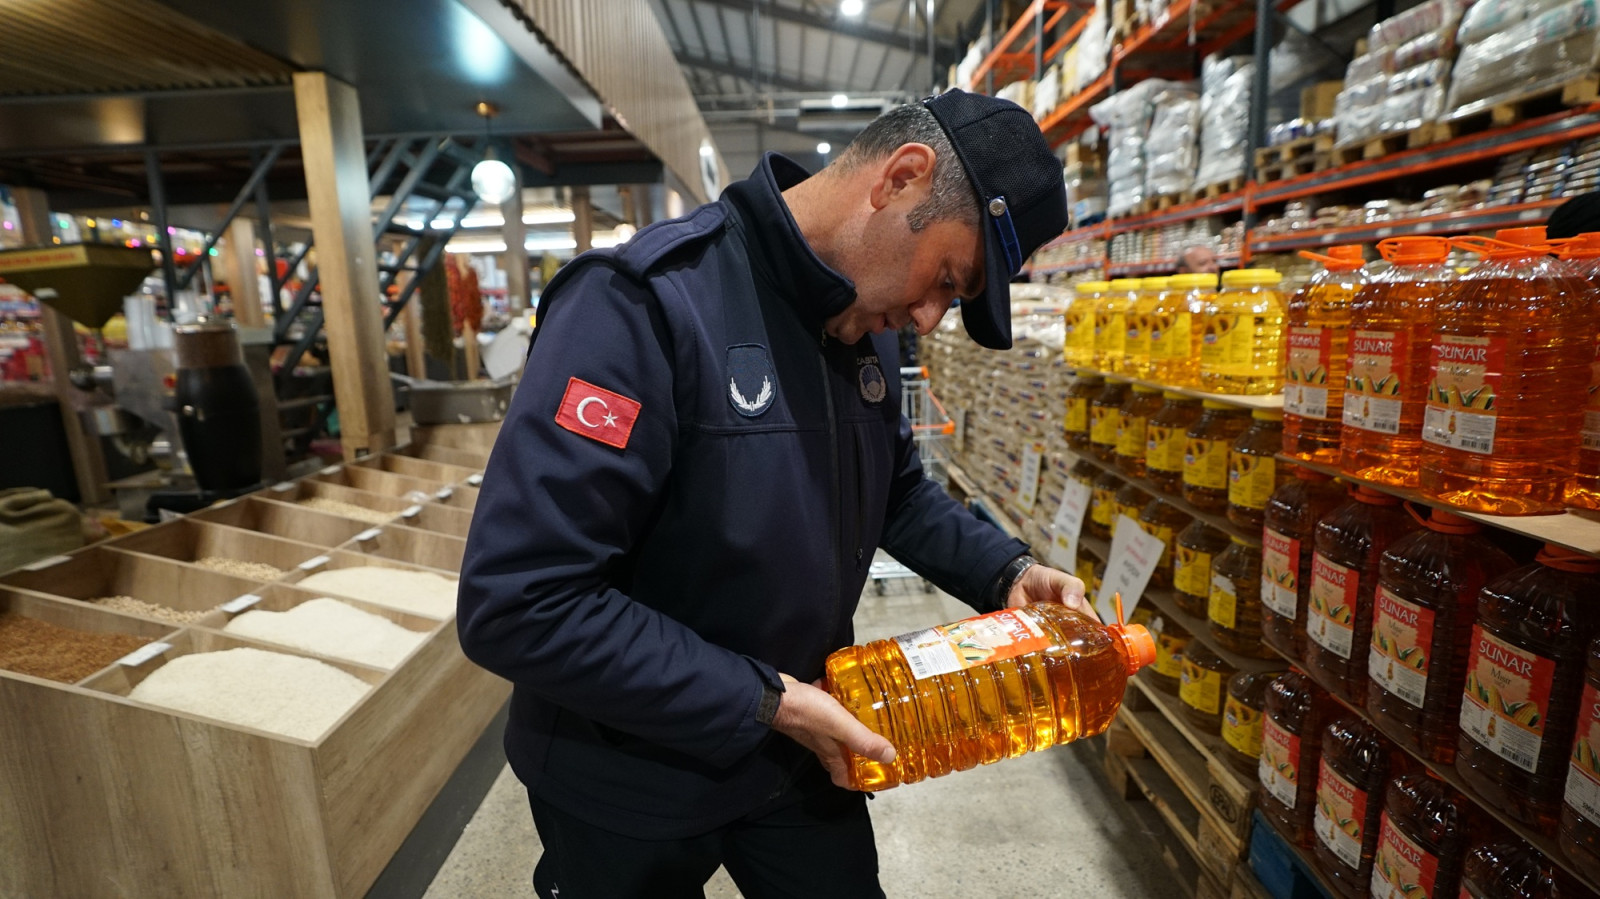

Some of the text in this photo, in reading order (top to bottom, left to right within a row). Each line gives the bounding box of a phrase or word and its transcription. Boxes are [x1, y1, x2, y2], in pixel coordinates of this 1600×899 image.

[1354, 339, 1393, 353] SUNAR
[1438, 345, 1487, 362] SUNAR
[1315, 562, 1346, 586] SUNAR
[1380, 596, 1418, 626] SUNAR
[1479, 640, 1533, 678] SUNAR
[1322, 769, 1354, 803] SUNAR
[1384, 825, 1423, 867] SUNAR
